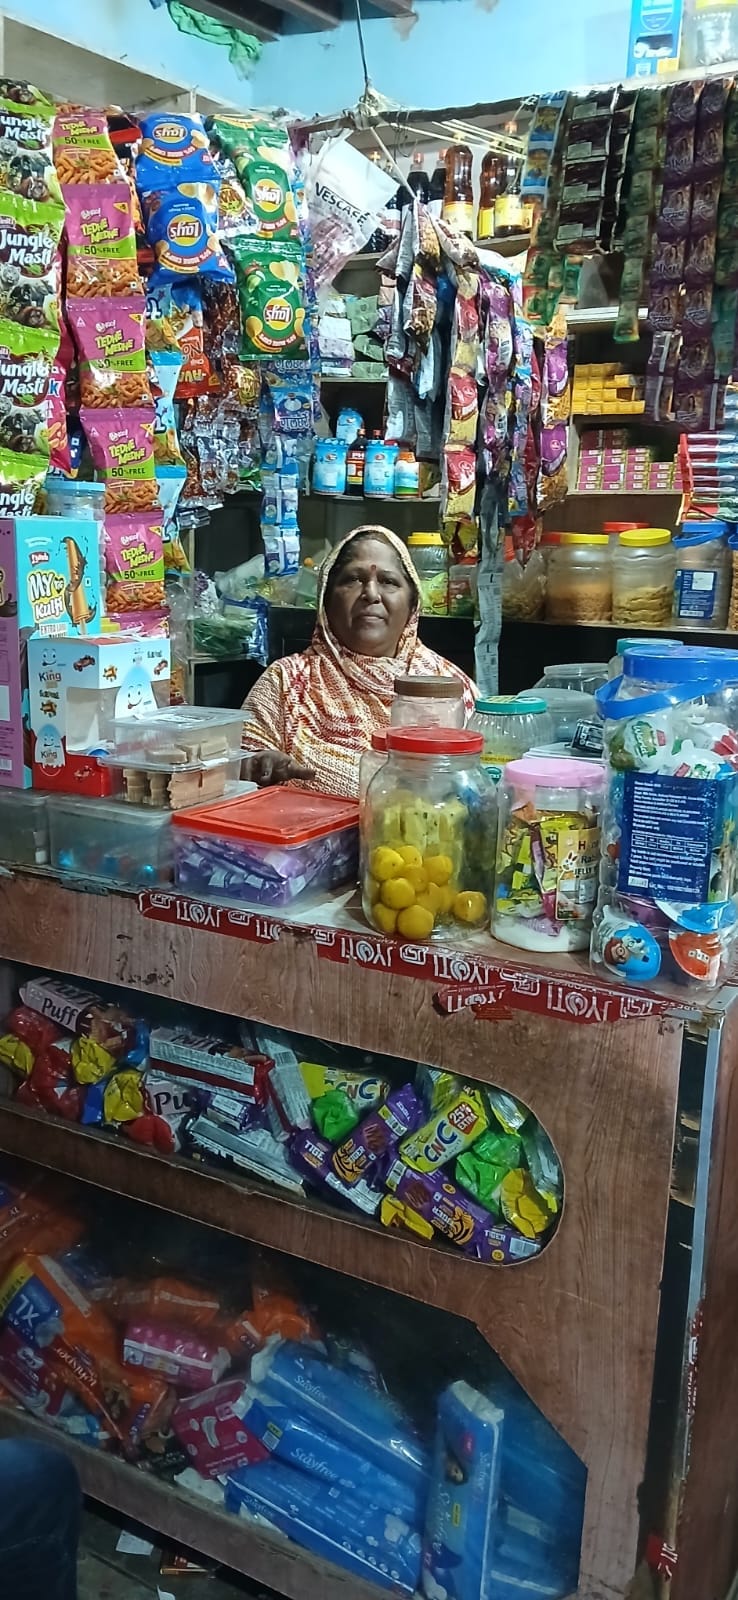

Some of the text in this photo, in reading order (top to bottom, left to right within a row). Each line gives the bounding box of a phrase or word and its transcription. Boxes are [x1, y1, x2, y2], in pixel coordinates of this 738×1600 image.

[0, 115, 45, 132] ungle
[169, 223, 200, 240] Lay's
[264, 305, 291, 322] Lay's
[0, 361, 48, 381] ungle
[116, 359, 133, 367] FREE
[129, 467, 146, 476] FREE
[0, 485, 34, 508] ngle
[140, 569, 155, 577] FREE
[29, 572, 55, 603] MY
[39, 671, 62, 682] King
[41, 751, 57, 760] King
[176, 899, 221, 928] JYOTI
[341, 937, 393, 967] JYOTI
[433, 953, 491, 985] JYOTI
[42, 997, 78, 1024] Puff
[547, 983, 612, 1022] JYOTI
[484, 1229, 506, 1242] TIGER
[16, 1294, 41, 1326] XL
[290, 1447, 338, 1482] Stayfree
